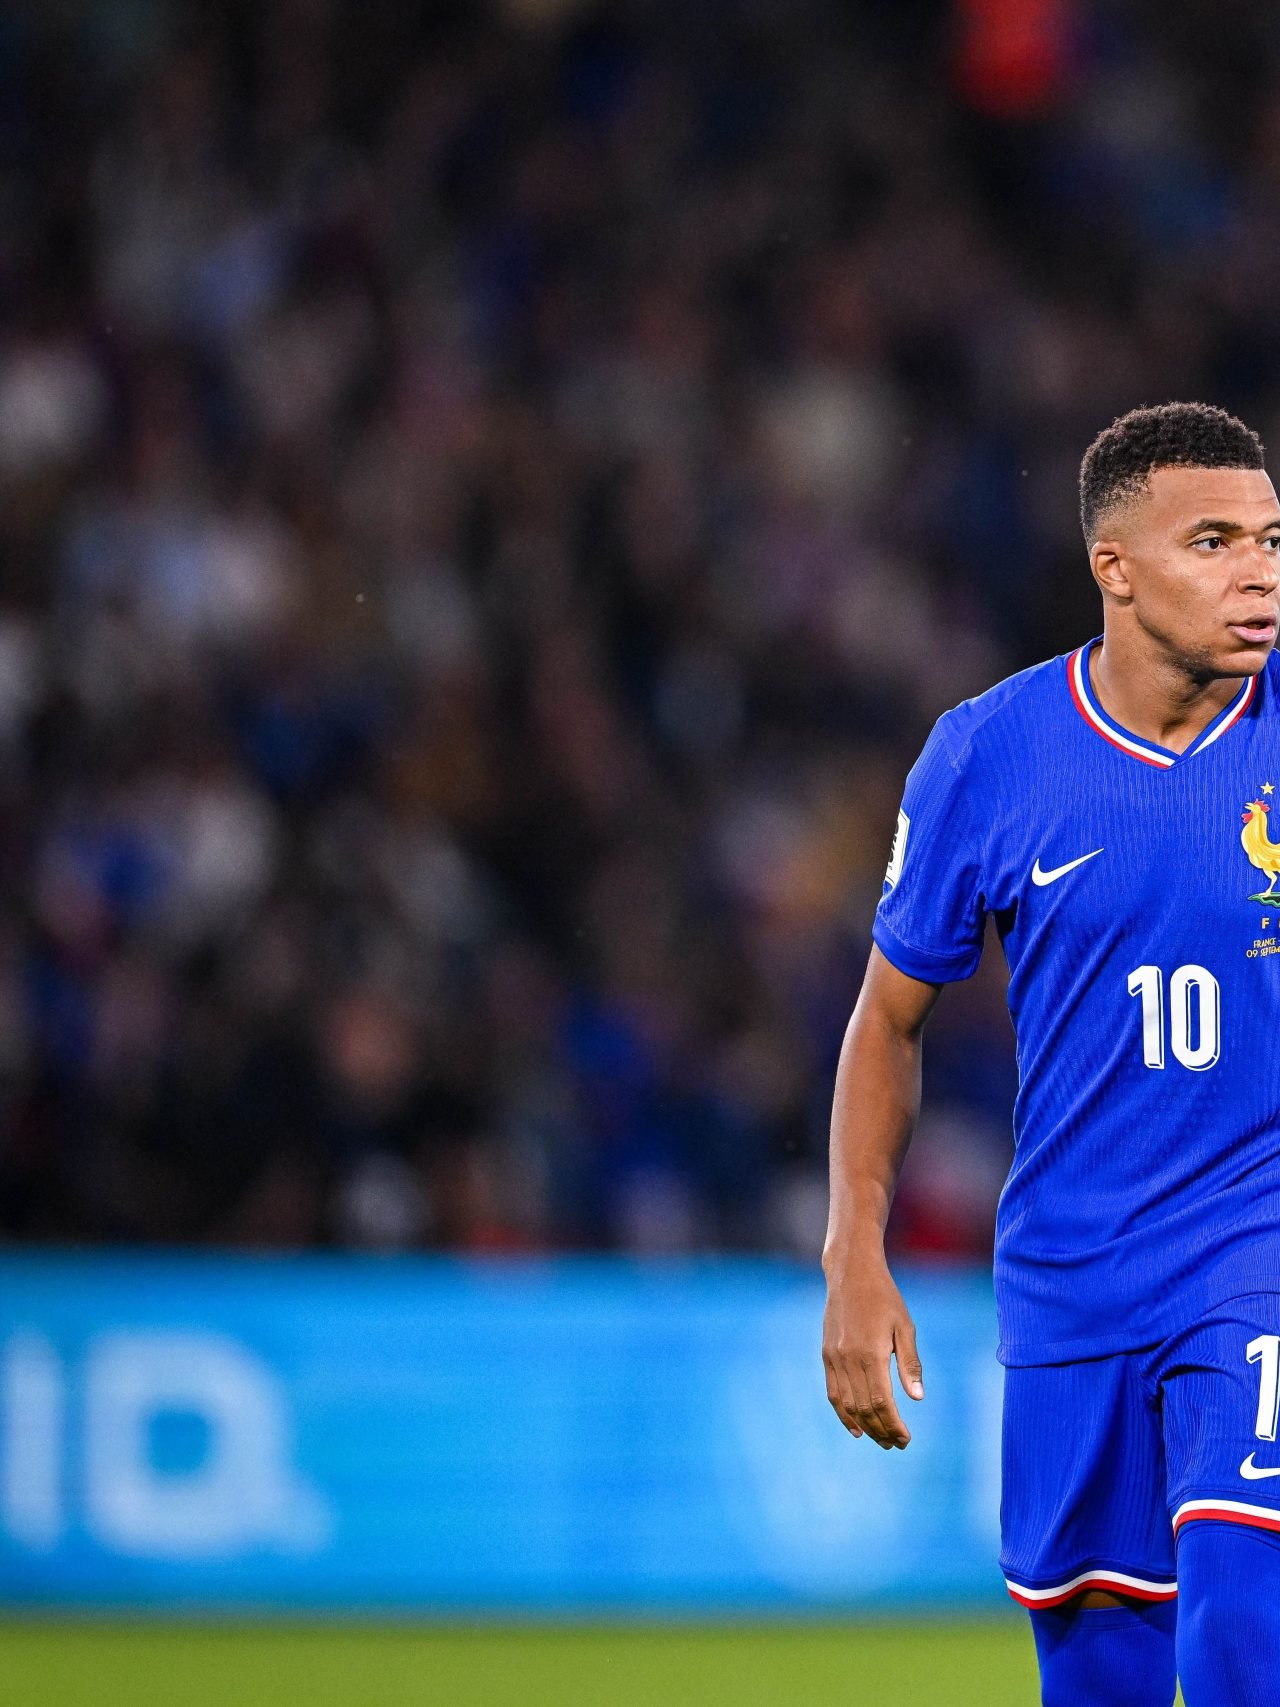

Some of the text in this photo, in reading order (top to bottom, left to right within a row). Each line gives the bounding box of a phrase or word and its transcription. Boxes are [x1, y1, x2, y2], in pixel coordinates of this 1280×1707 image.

[1253, 937, 1276, 948] FRANCE
[1246, 949, 1258, 958] 09
[1128, 964, 1220, 1072] 10
